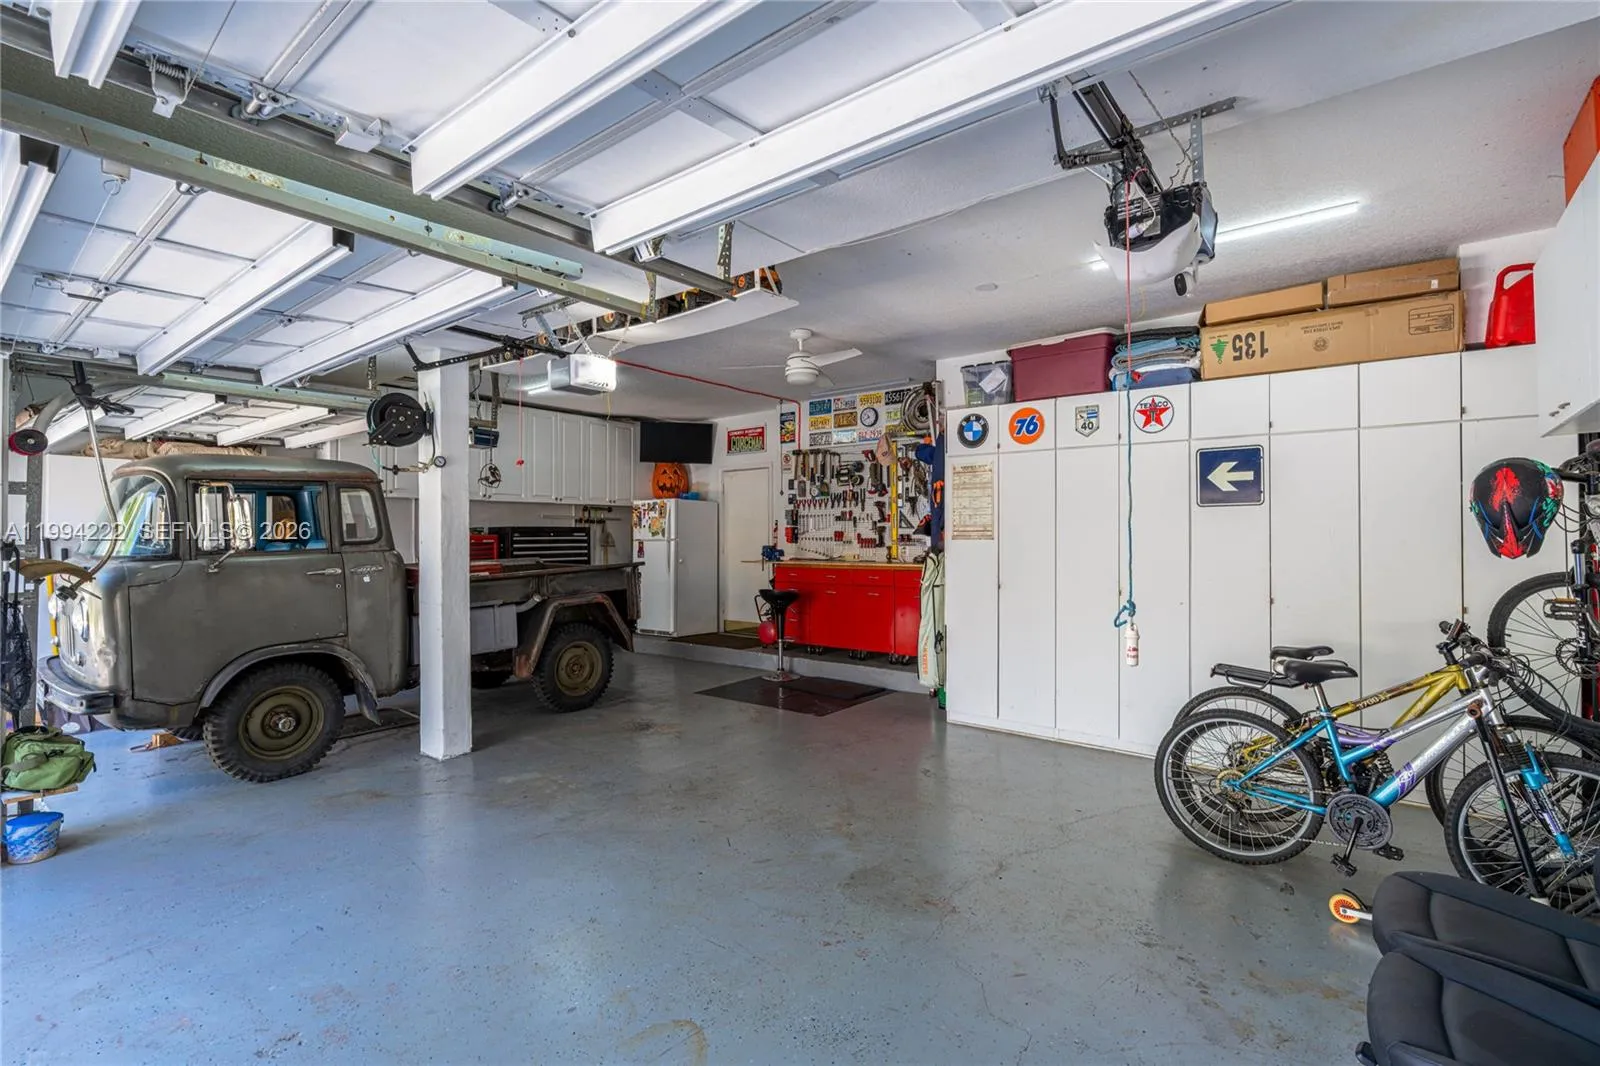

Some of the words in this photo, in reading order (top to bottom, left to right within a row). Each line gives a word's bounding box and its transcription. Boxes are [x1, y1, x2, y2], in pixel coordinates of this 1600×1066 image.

[1232, 331, 1269, 362] 135
[1139, 400, 1169, 409] TEXACO
[961, 415, 985, 427] BMW
[1013, 415, 1040, 436] 76
[1080, 420, 1094, 431] 40
